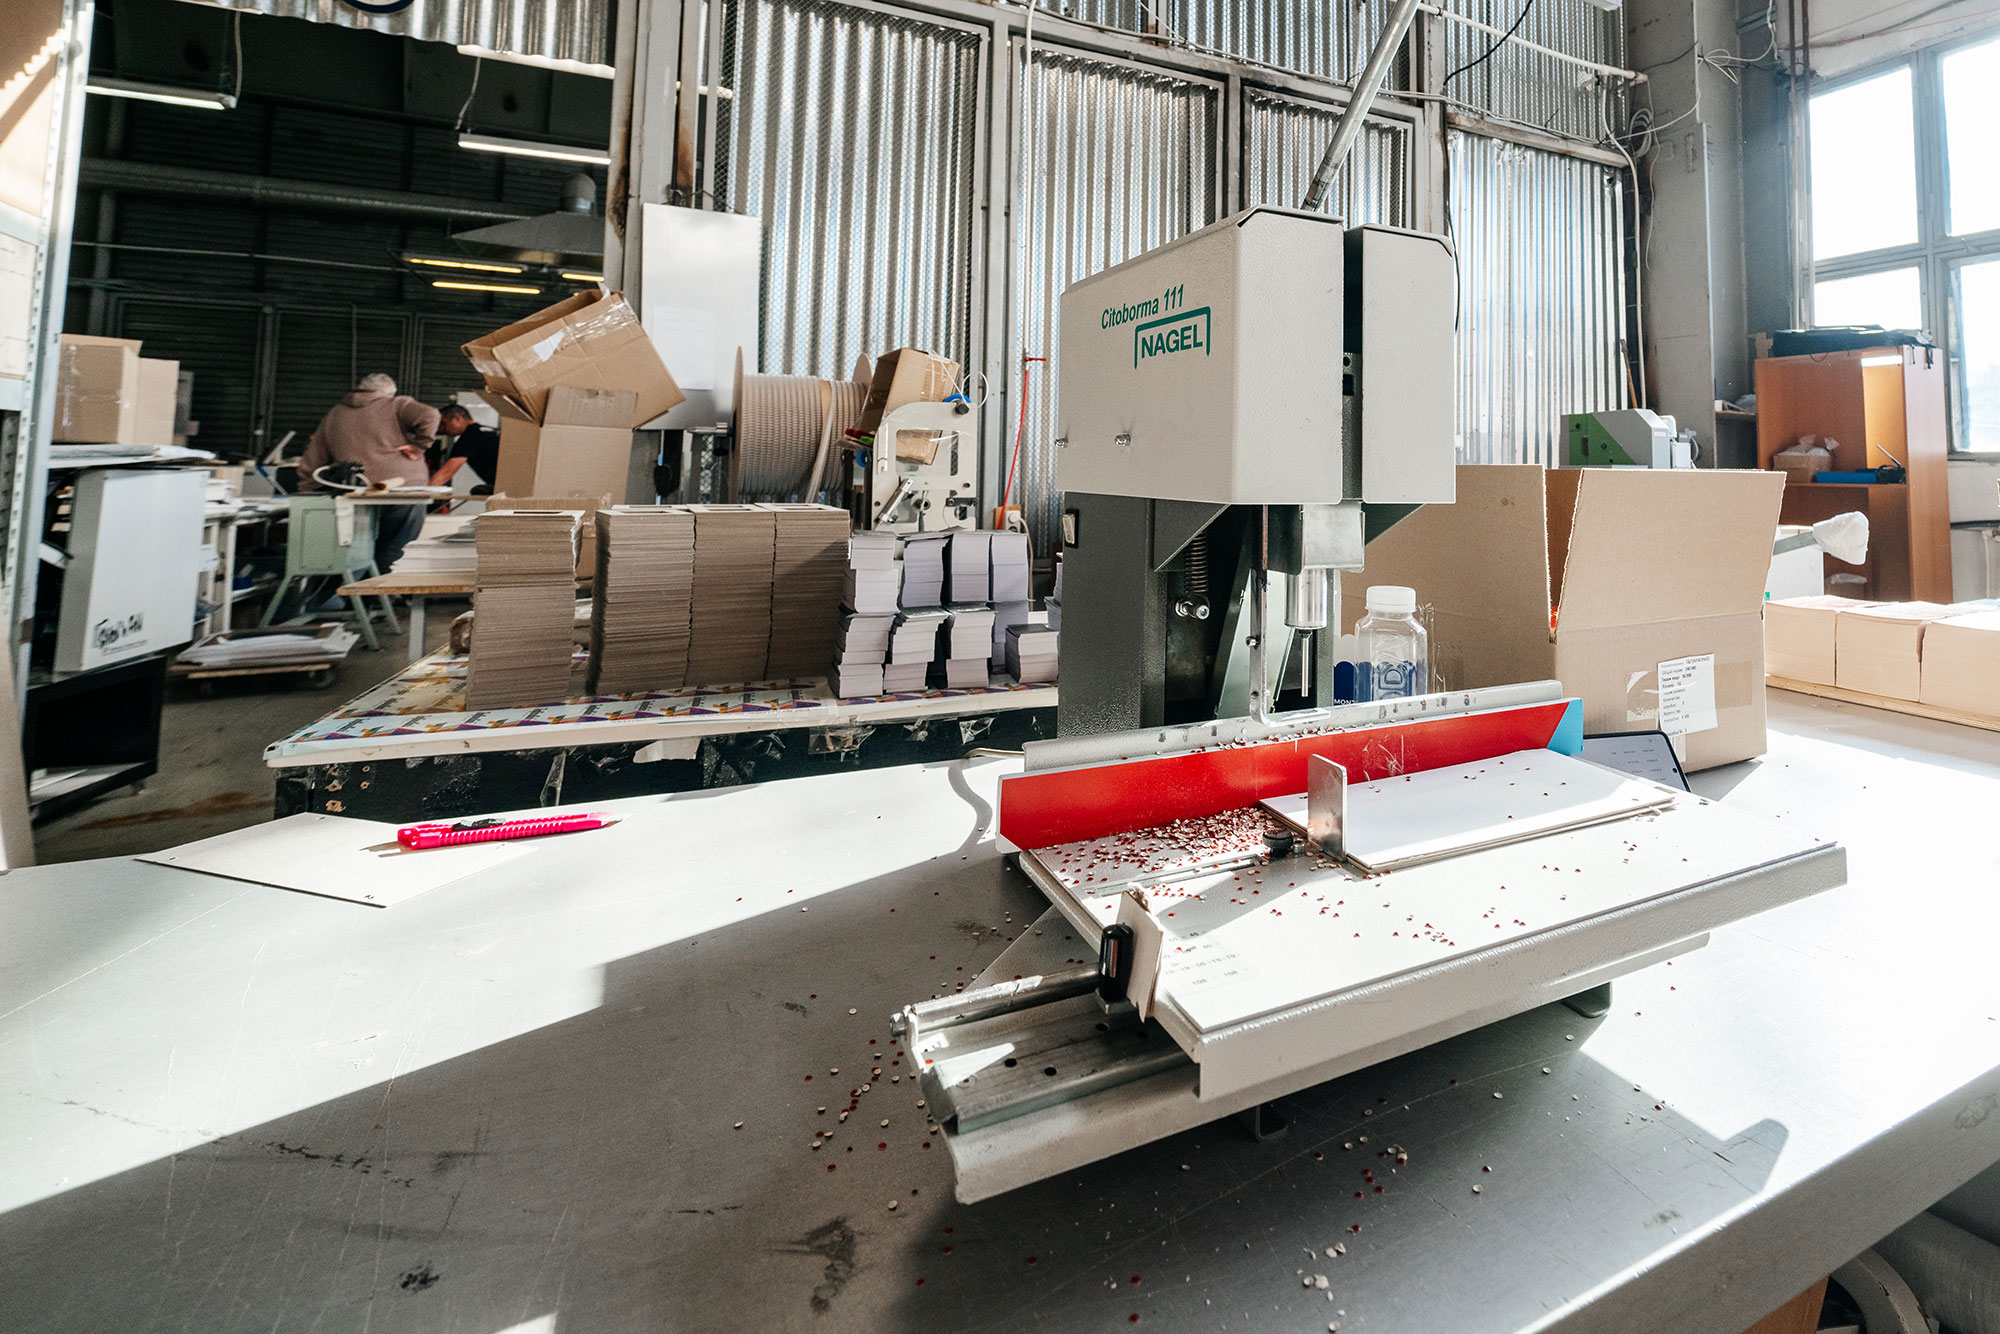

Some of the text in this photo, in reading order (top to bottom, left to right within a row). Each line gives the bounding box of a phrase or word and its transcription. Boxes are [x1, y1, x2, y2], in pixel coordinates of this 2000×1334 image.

[1101, 283, 1184, 330] Citoborma 111
[1141, 323, 1204, 359] NAGEL
